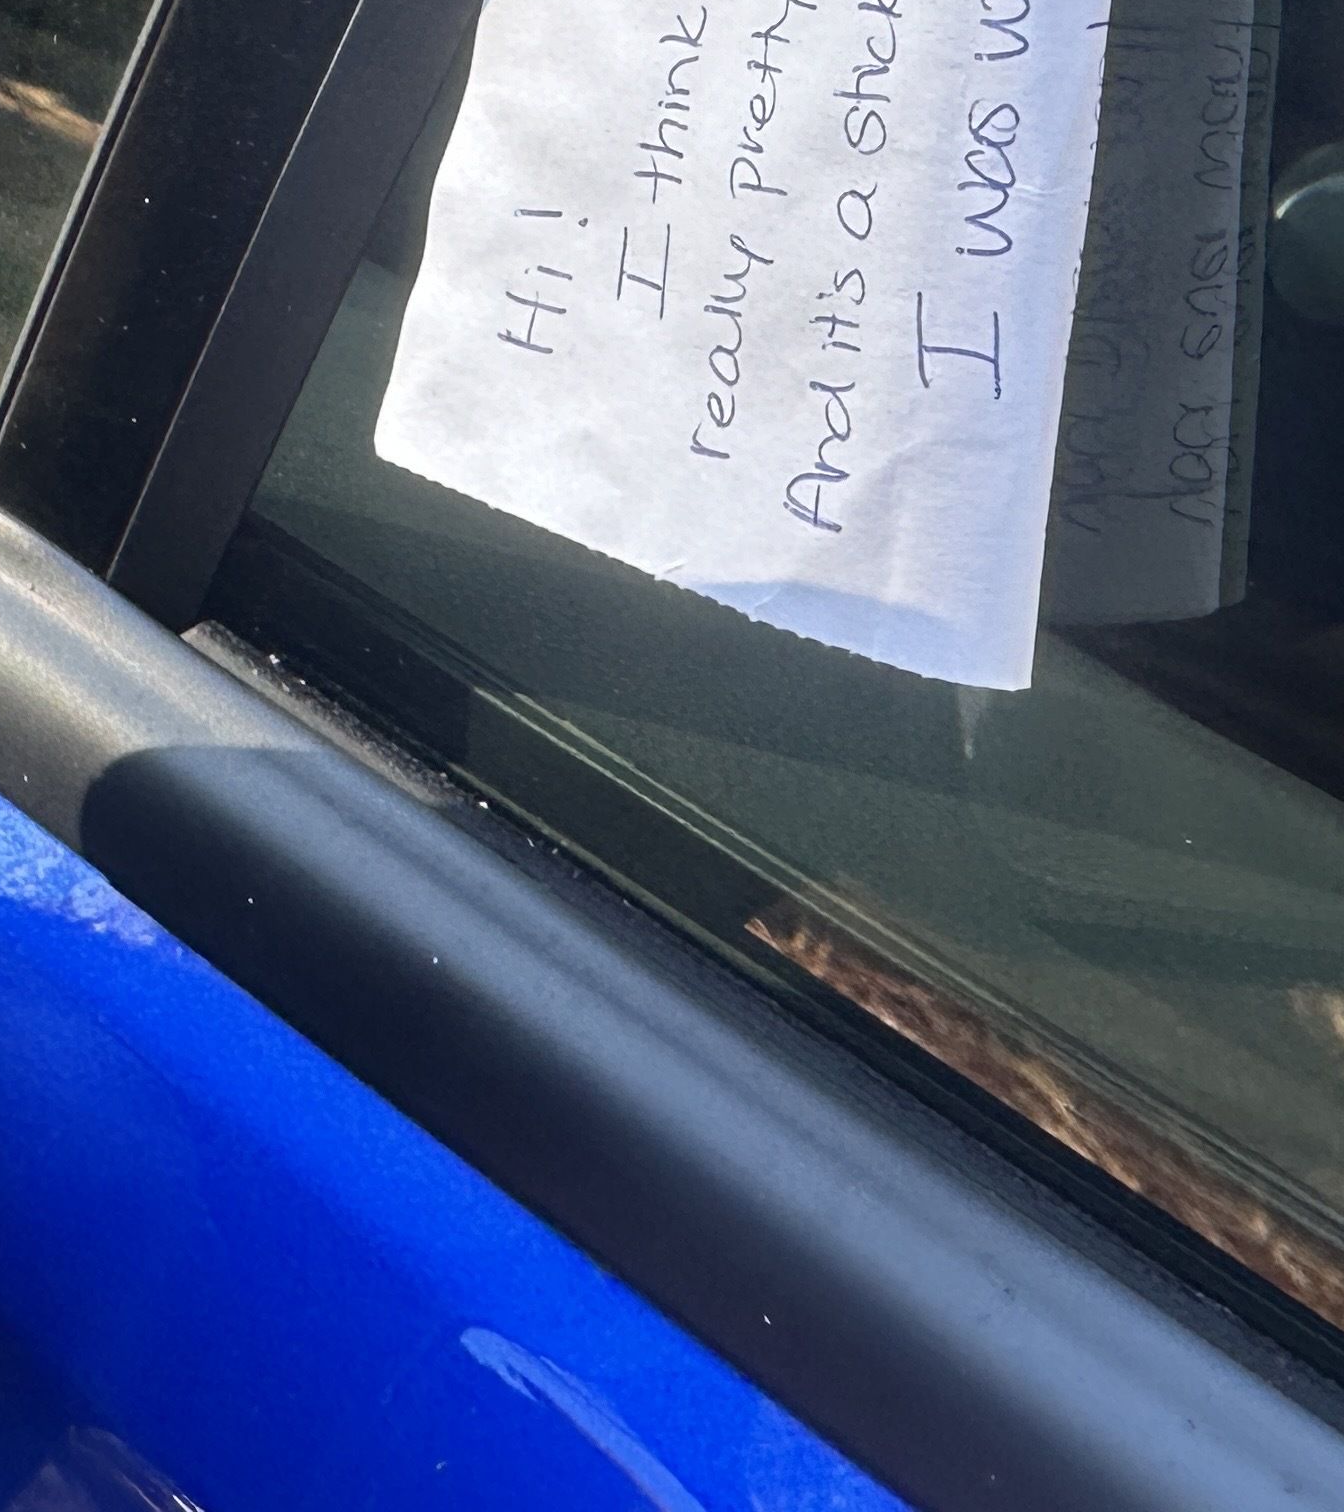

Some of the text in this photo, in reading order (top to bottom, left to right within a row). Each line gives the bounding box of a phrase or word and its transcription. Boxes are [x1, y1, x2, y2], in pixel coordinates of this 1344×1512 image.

[634, 5, 707, 204] think
[956, 98, 1020, 256] was
[617, 224, 670, 319] I
[690, 234, 774, 458] really
[783, 381, 857, 533] And
[837, 182, 877, 240] a
[917, 291, 1002, 400] I
